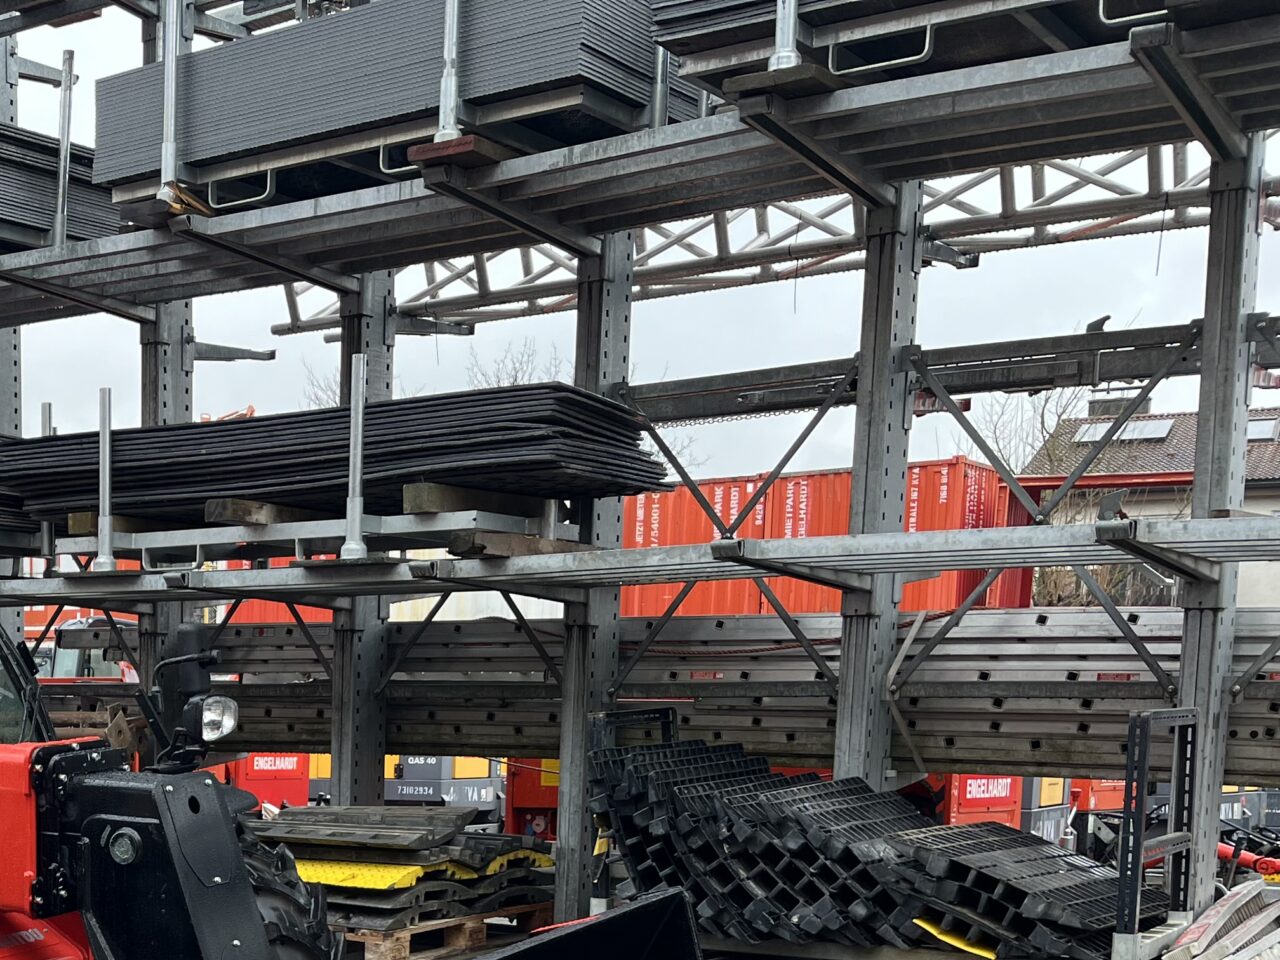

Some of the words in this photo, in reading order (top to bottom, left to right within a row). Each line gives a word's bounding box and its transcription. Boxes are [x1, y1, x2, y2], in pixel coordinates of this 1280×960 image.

[253, 756, 298, 771] ENGELHARDT
[426, 756, 437, 765] 40
[966, 777, 1012, 799] ENGELHARDT
